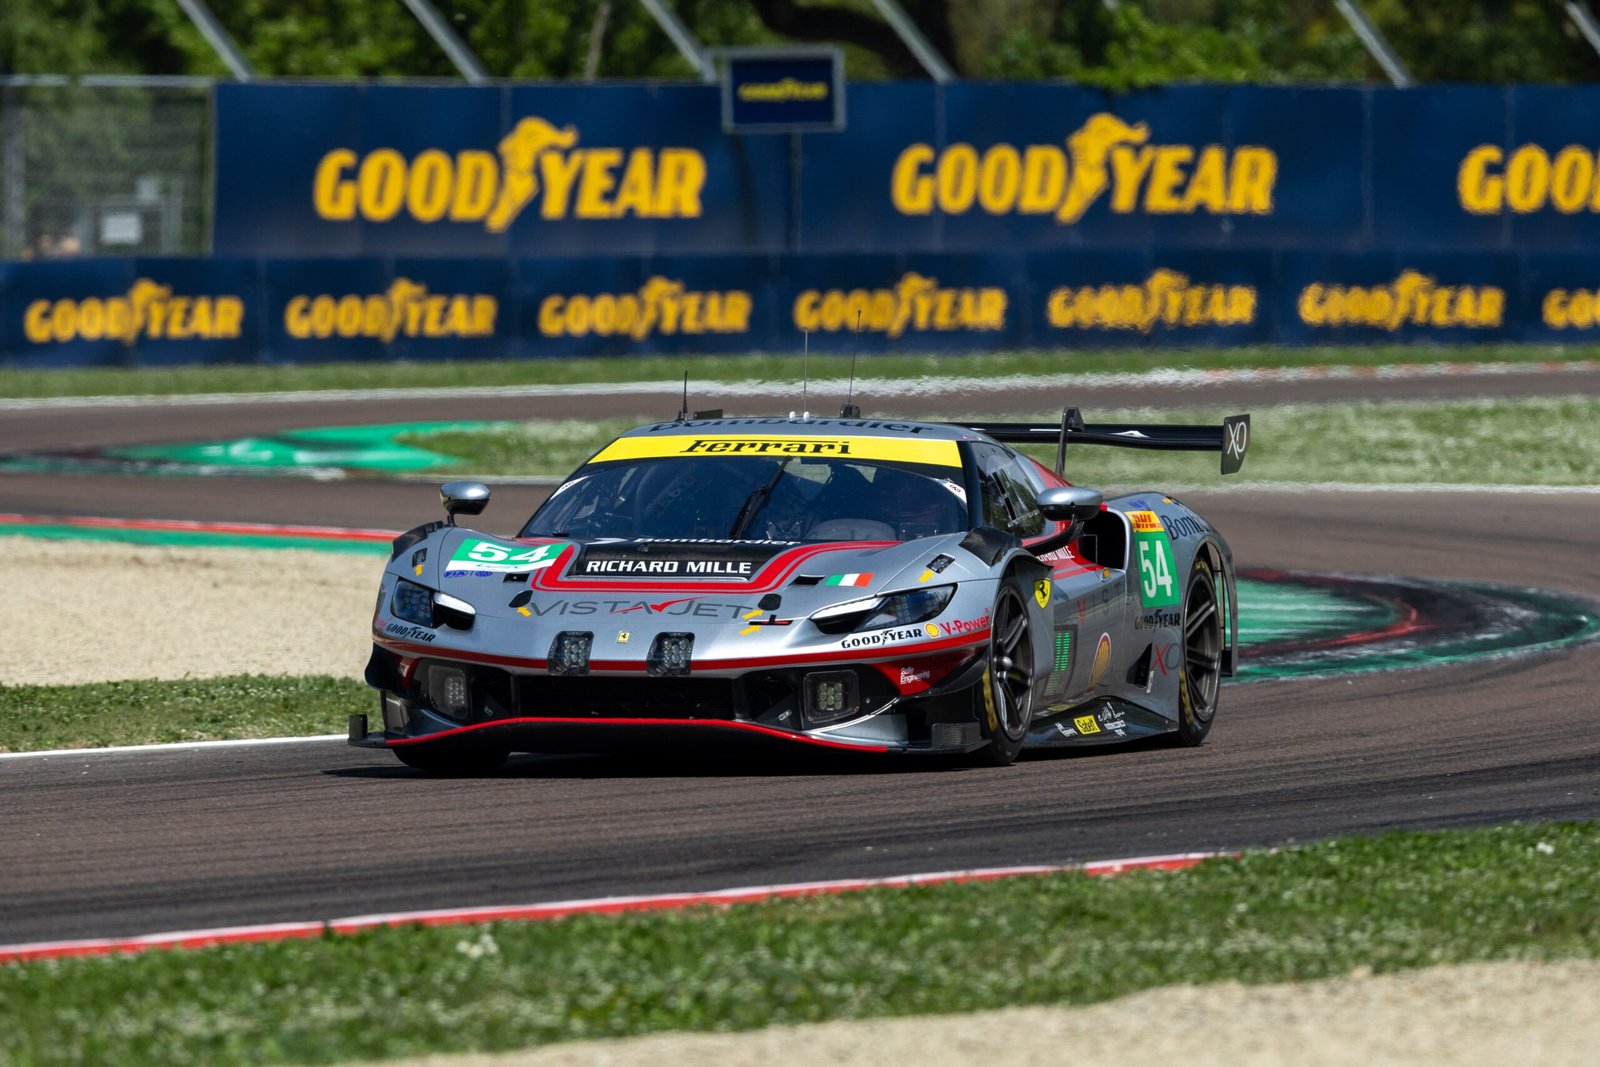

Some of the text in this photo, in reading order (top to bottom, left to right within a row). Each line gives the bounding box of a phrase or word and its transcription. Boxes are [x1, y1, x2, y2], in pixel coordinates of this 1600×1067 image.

[313, 146, 706, 222] GOODYEAR
[891, 143, 1278, 215] GOODYEAR
[1457, 143, 1600, 215] GOO
[25, 294, 244, 341] GOODYEAR
[285, 293, 497, 339] GOODYEAR
[539, 290, 752, 336] GOODYEAR
[794, 287, 1006, 333] GOODYEAR
[1048, 283, 1257, 329] GOODYEAR
[1299, 284, 1504, 328] GOODYEAR
[1542, 288, 1600, 329] GO
[680, 439, 851, 454] Ferrari
[1227, 421, 1247, 460] XO
[468, 541, 552, 563] 54
[586, 560, 752, 574] RICHARD MILLE
[1138, 540, 1173, 599] 54
[386, 623, 436, 642] GOODYEAR
[841, 628, 923, 649] GOODYEAR
[940, 615, 990, 635] V-Power
[1135, 611, 1181, 631] GOODYEAR
[1151, 642, 1181, 677] XO
